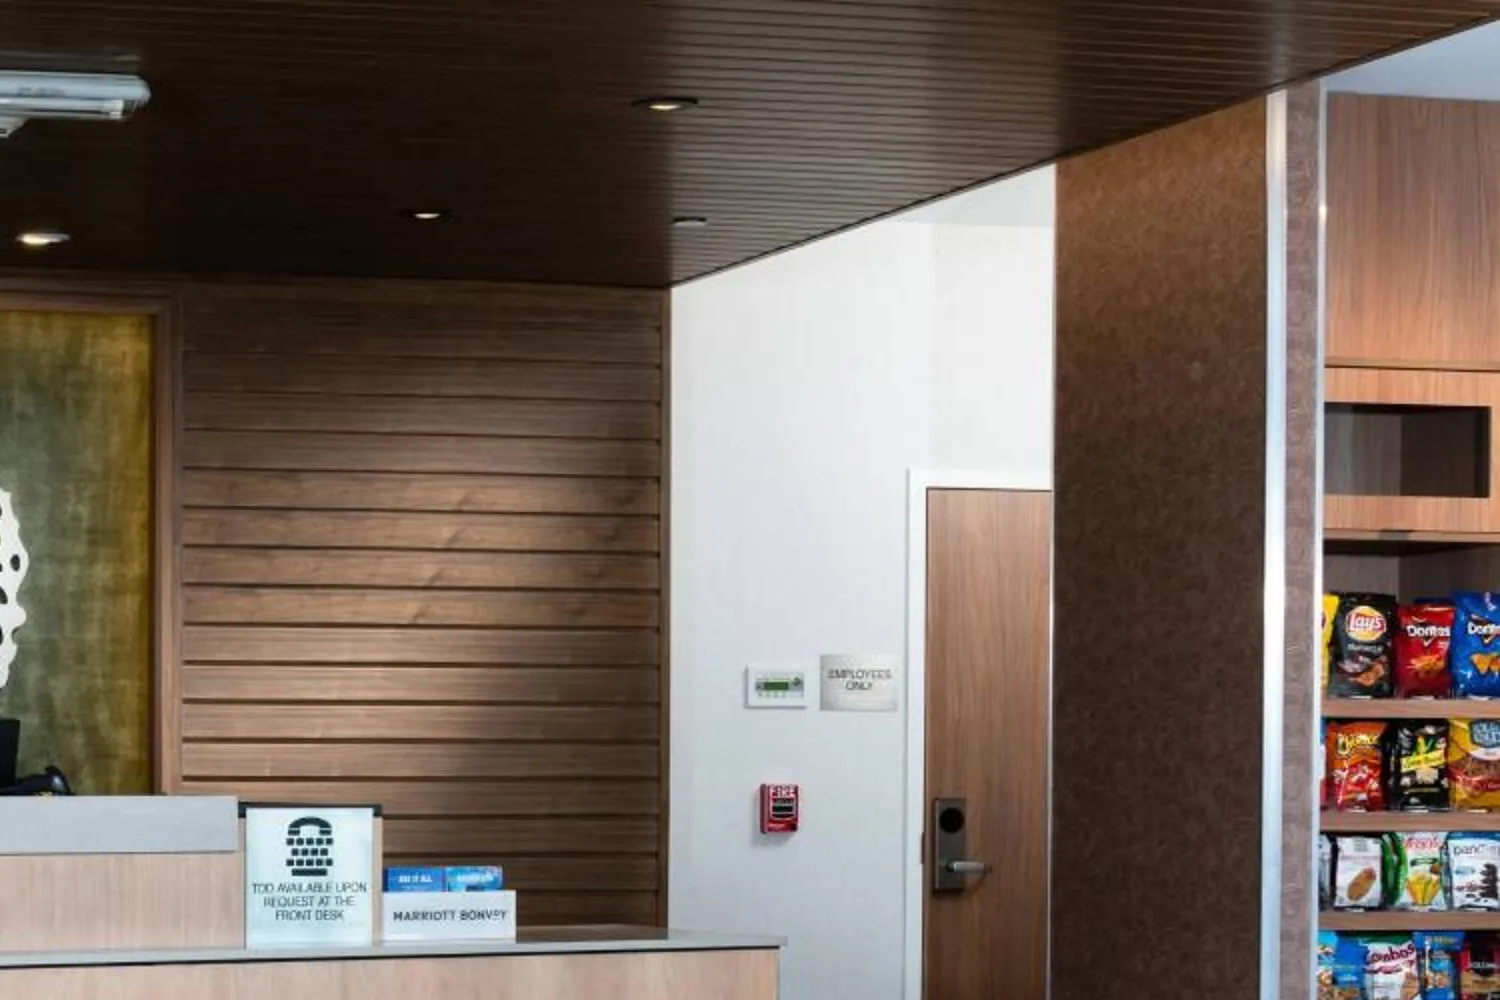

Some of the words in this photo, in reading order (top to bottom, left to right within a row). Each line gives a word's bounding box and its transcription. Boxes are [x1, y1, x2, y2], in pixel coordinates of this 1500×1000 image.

[827, 668, 892, 679] EMPLOYEES
[845, 681, 873, 691] ONLY
[277, 882, 332, 893] AVAILABLE
[336, 881, 367, 892] UPON
[263, 896, 314, 907] REQUEST
[317, 896, 330, 906] AT
[335, 896, 355, 906] THE
[275, 910, 312, 920] FRONT
[315, 910, 344, 920] DESK
[393, 911, 456, 921] MARRIOTT
[460, 910, 507, 920] BONVOY
